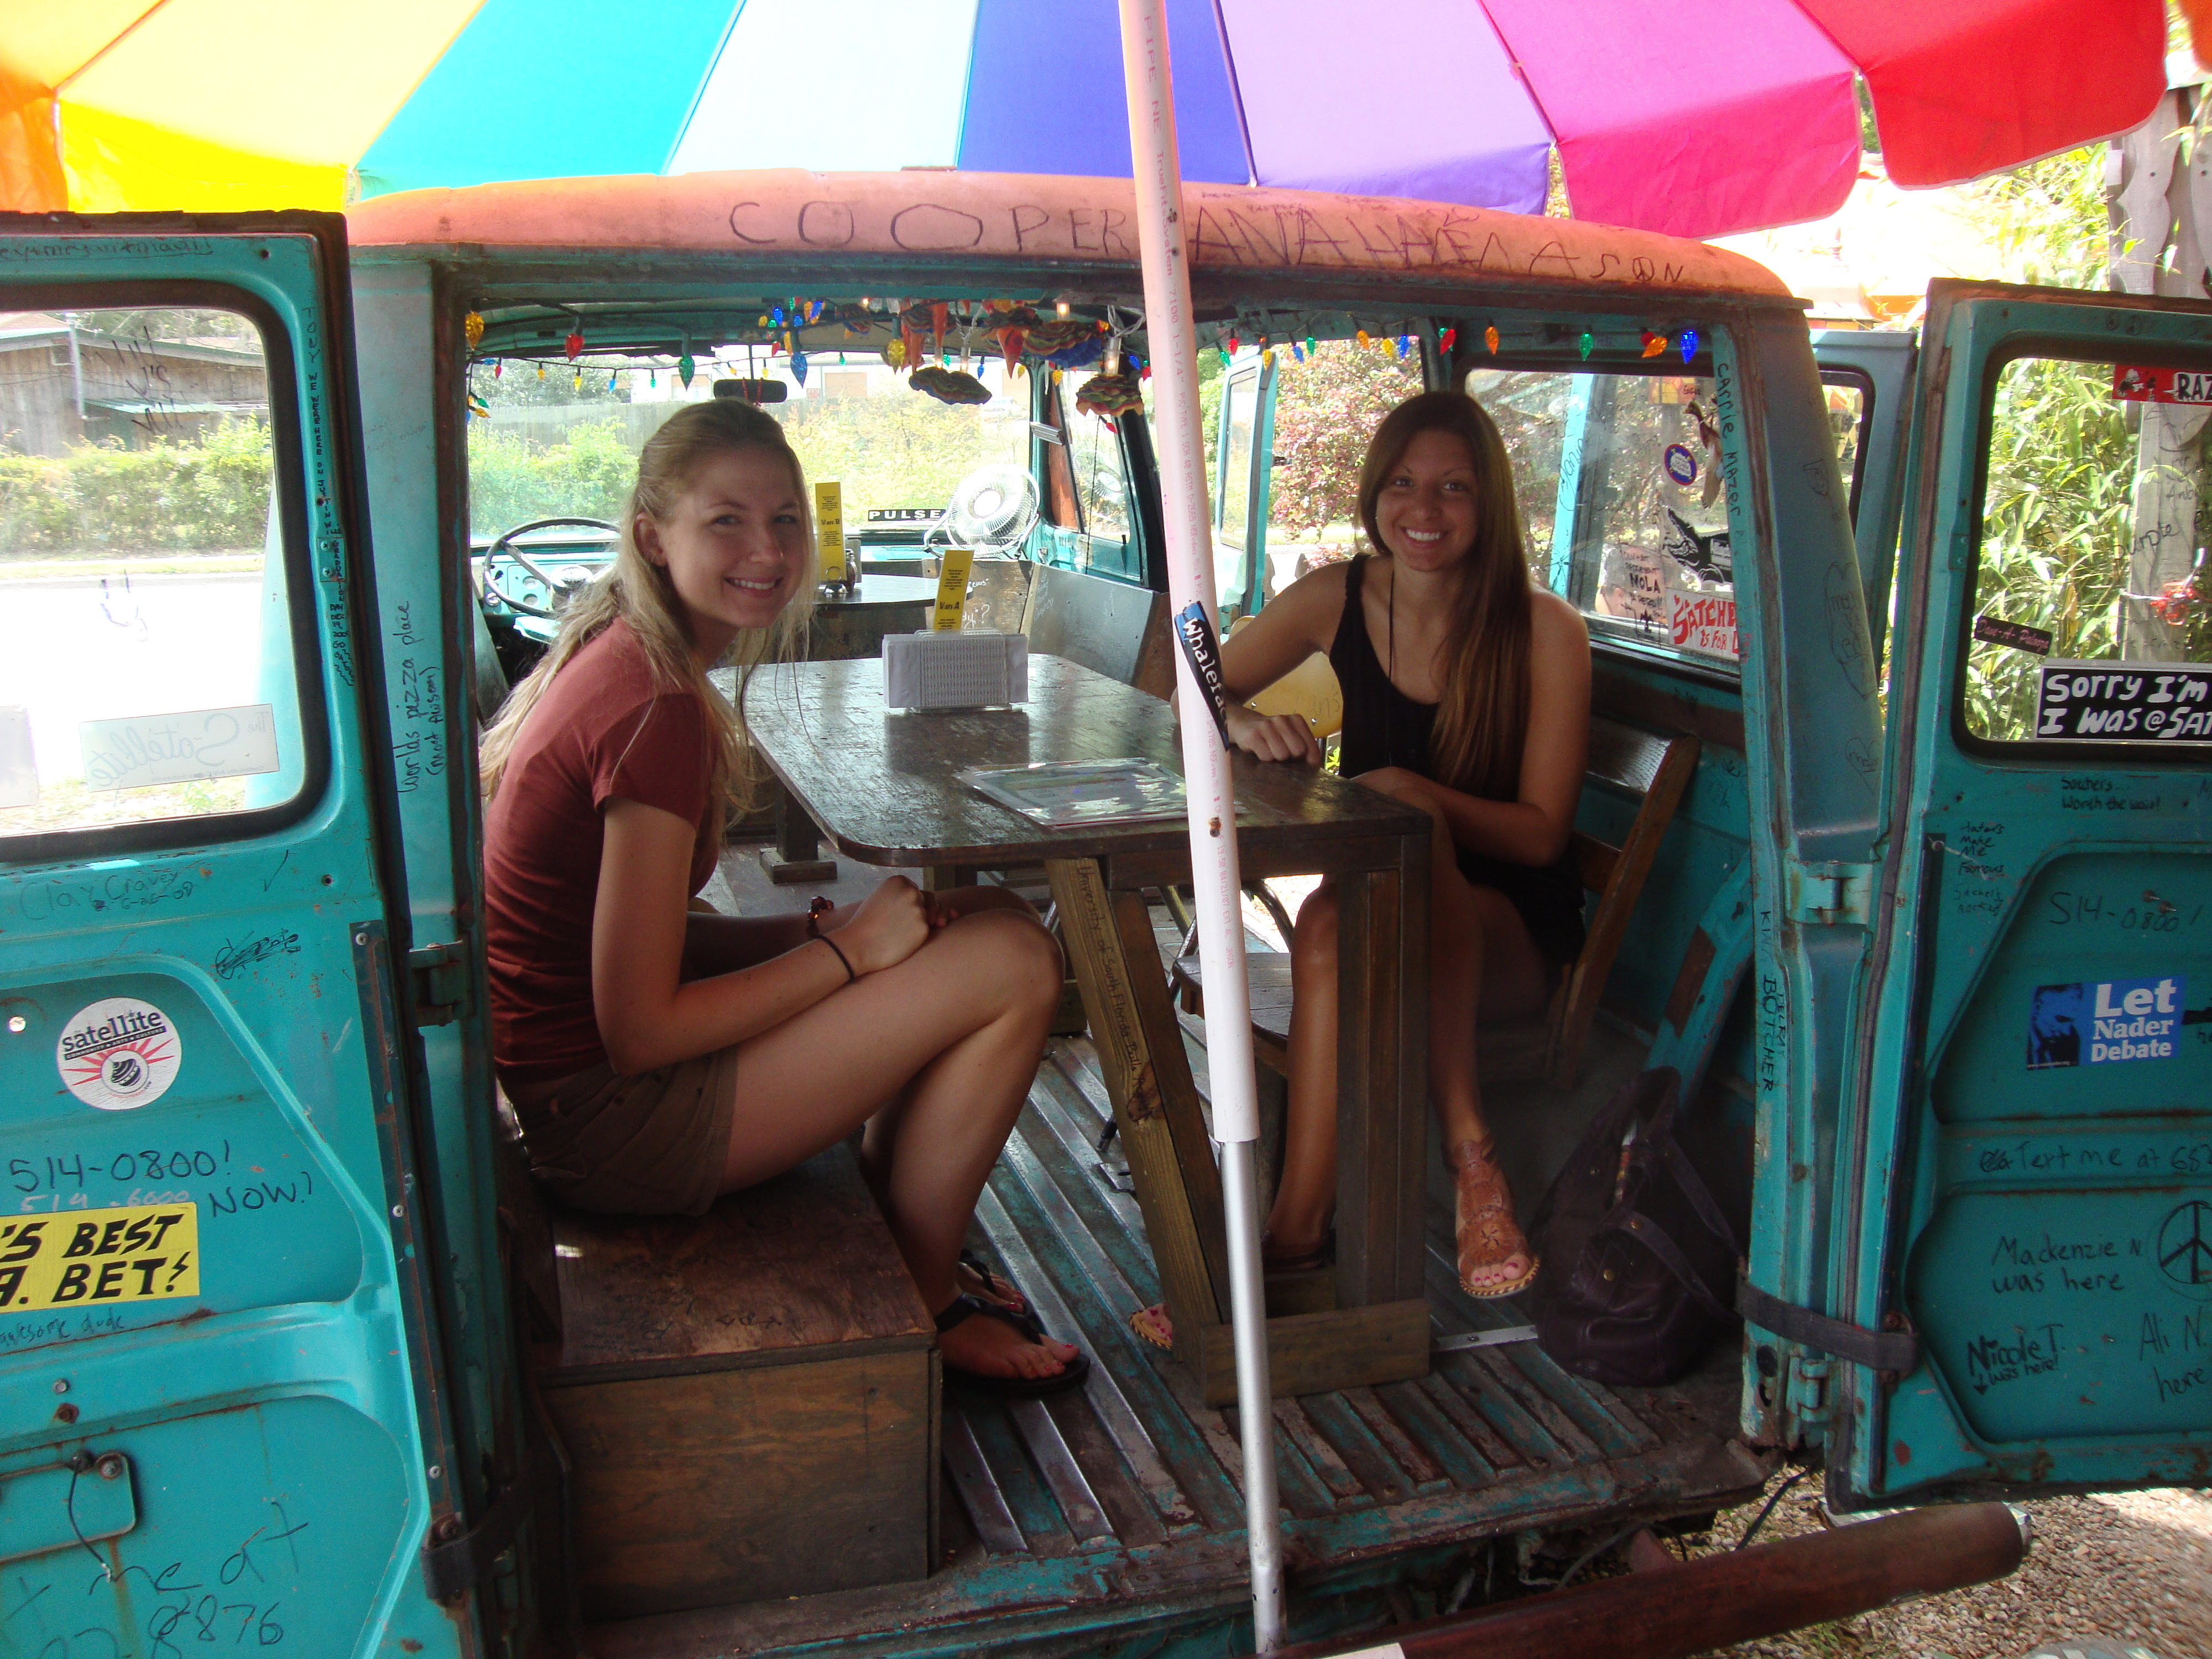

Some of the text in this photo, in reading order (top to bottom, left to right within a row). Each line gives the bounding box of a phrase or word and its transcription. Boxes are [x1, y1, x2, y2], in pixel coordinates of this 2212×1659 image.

[729, 200, 1130, 255] COOPER
[869, 510, 941, 520] PULSE
[392, 600, 424, 646] place
[395, 658, 429, 719] pizza
[2046, 674, 2208, 703] Sorry I'm
[2038, 708, 2068, 734] I
[2094, 978, 2177, 1018] Let
[62, 1010, 163, 1052] satellite
[2092, 1016, 2174, 1040] Nader
[2091, 1039, 2172, 1062] Debate
[62, 1213, 186, 1260] BEST
[2061, 1266, 2125, 1291] here
